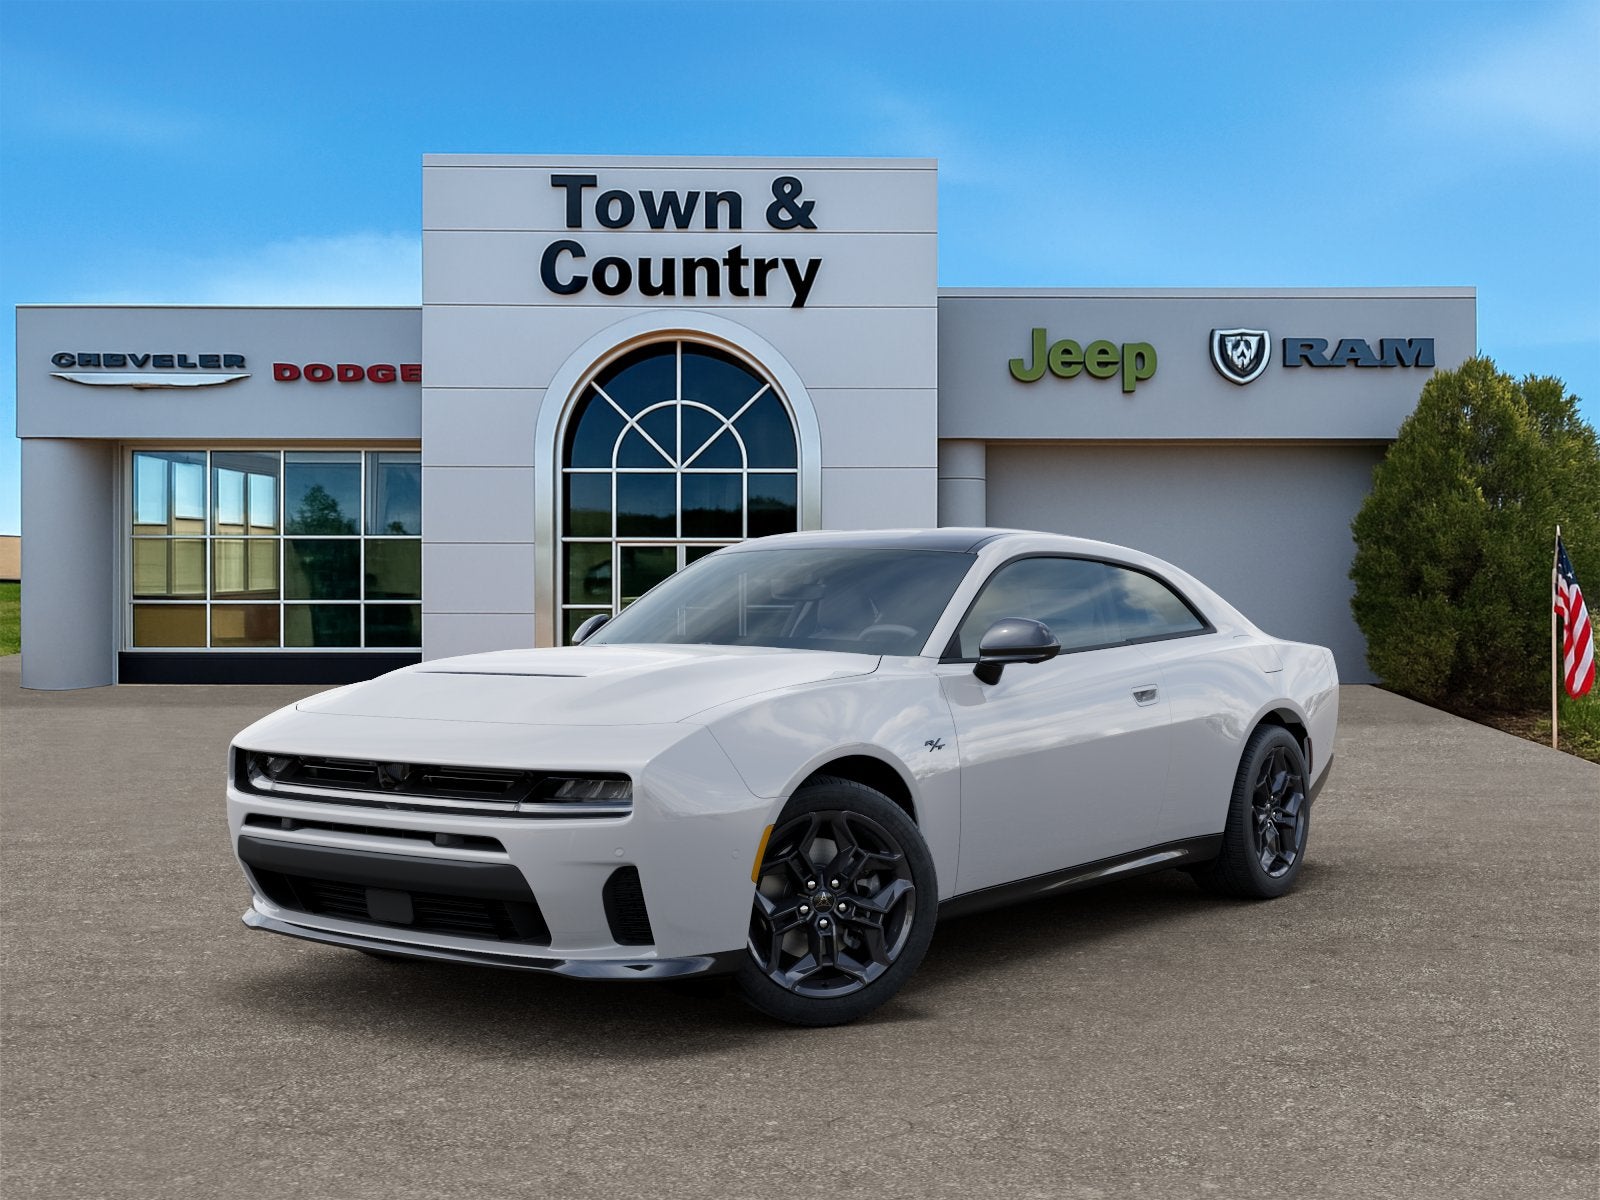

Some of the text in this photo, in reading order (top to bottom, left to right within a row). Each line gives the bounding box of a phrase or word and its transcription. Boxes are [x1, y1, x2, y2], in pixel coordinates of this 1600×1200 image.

[550, 174, 818, 230] Town &
[540, 239, 822, 308] Country
[272, 362, 422, 383] DODGE
[1008, 328, 1158, 393] Jeep
[1282, 337, 1436, 368] RAM
